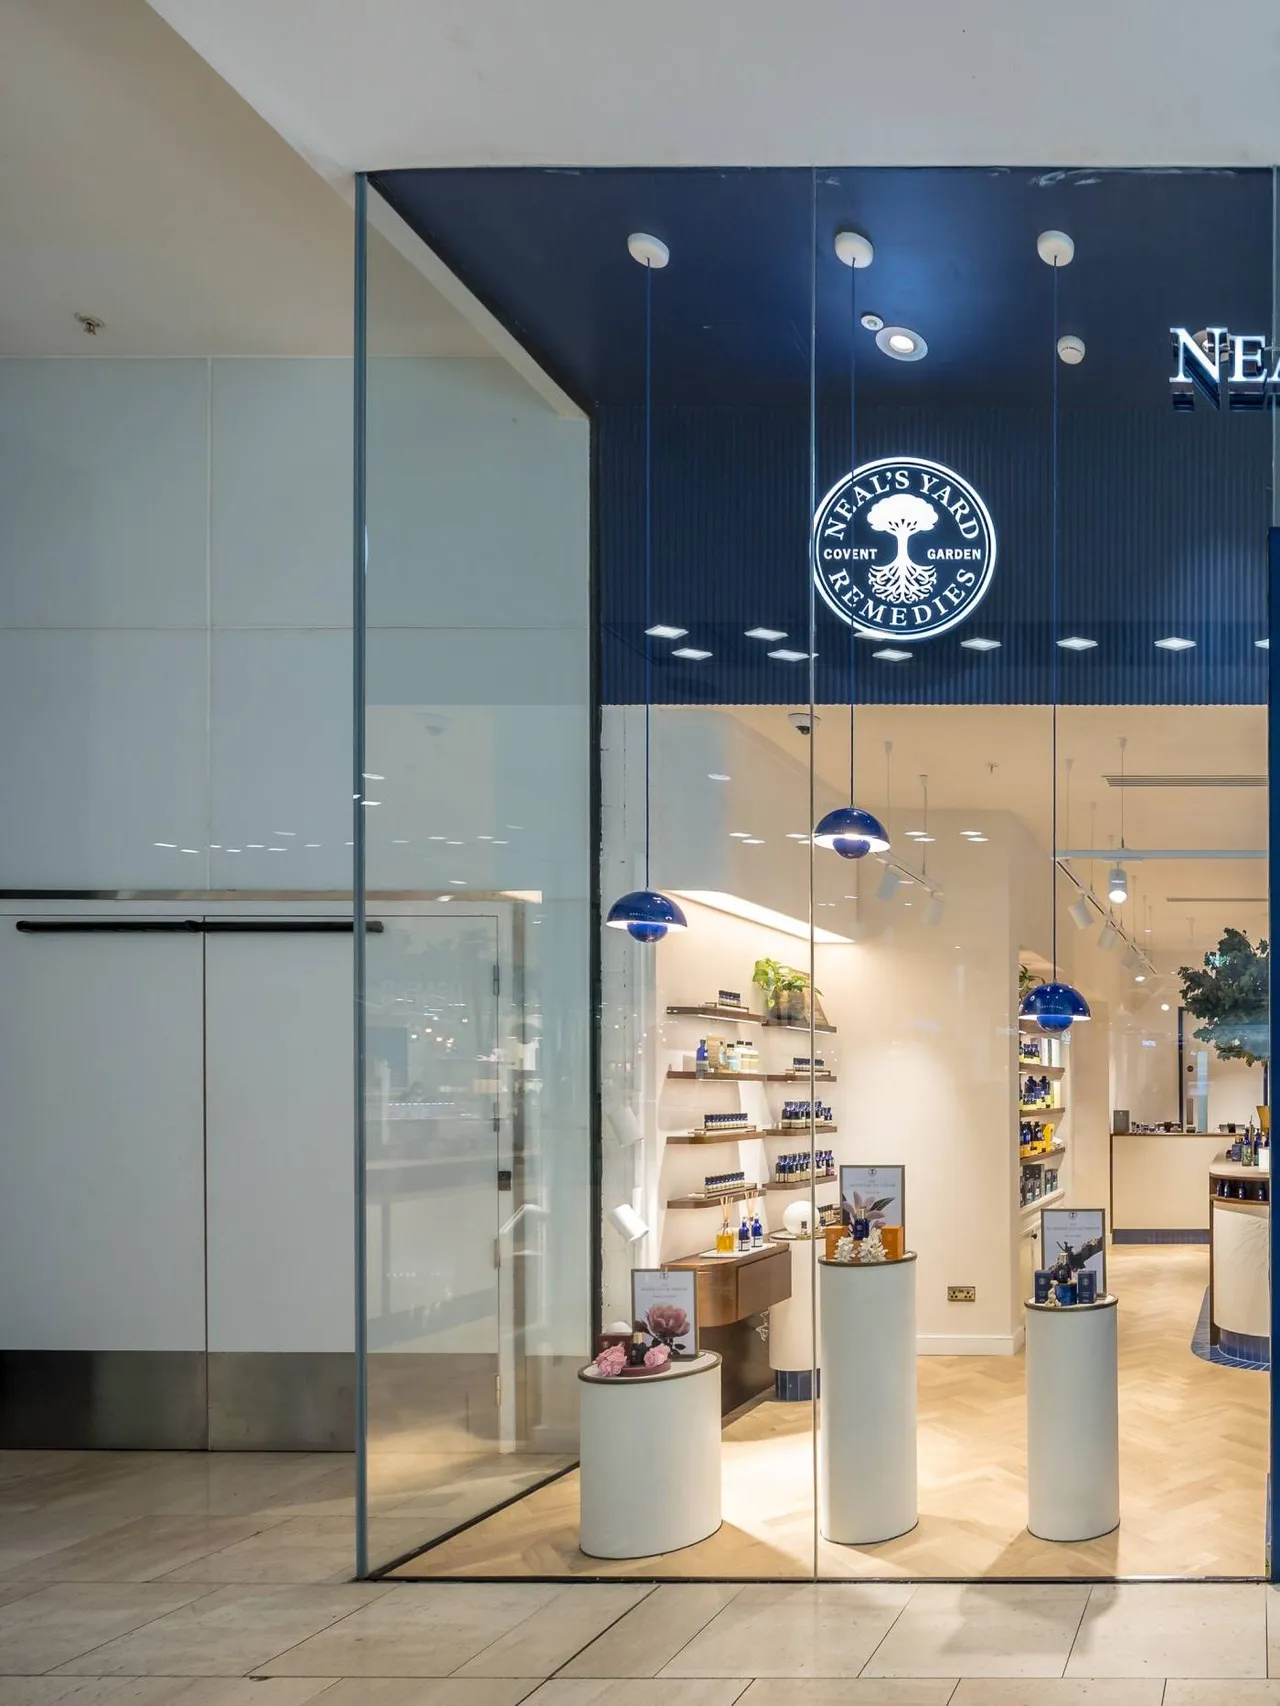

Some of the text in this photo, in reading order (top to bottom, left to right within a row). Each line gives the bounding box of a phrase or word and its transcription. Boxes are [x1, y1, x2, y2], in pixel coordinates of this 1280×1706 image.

[824, 470, 980, 541] NEAL'S YARD
[823, 548, 981, 560] COVENT GARDEN
[828, 568, 976, 626] REMEDIES
